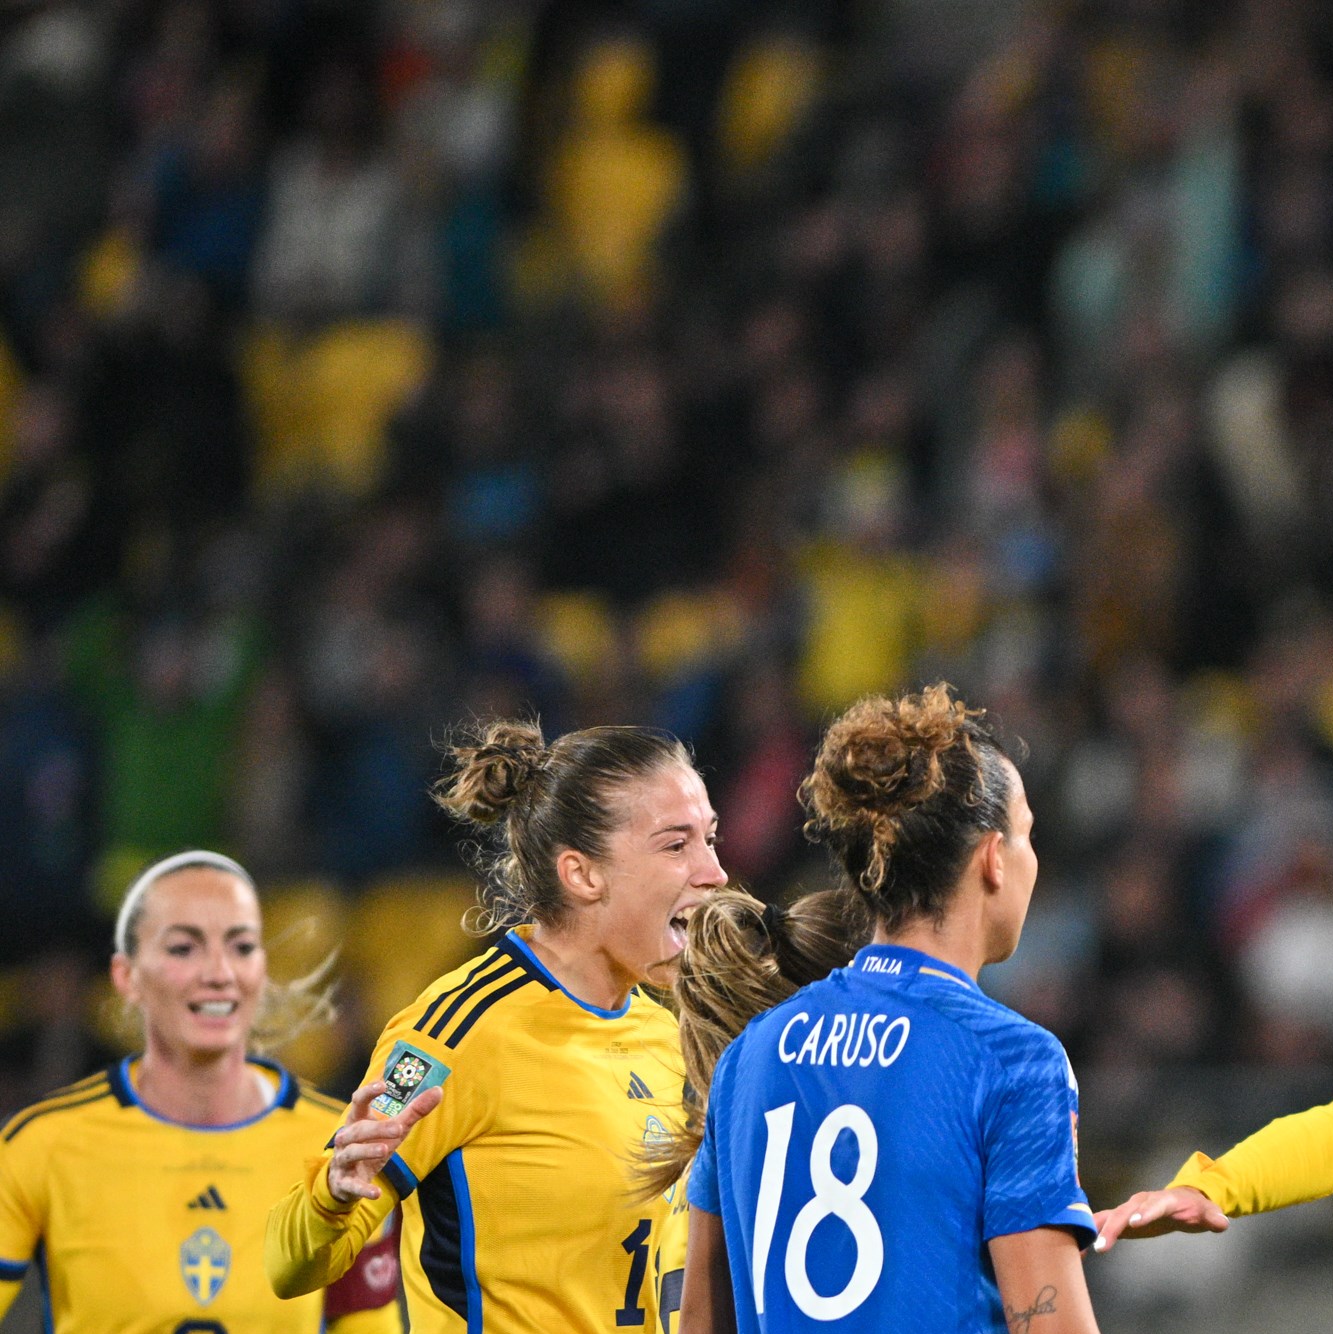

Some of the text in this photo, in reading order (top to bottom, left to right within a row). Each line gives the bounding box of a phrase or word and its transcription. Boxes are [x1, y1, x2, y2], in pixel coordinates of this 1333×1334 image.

[862, 956, 903, 976] ITALIA
[778, 1012, 911, 1069] CARUSO
[753, 1101, 885, 1322] 18
